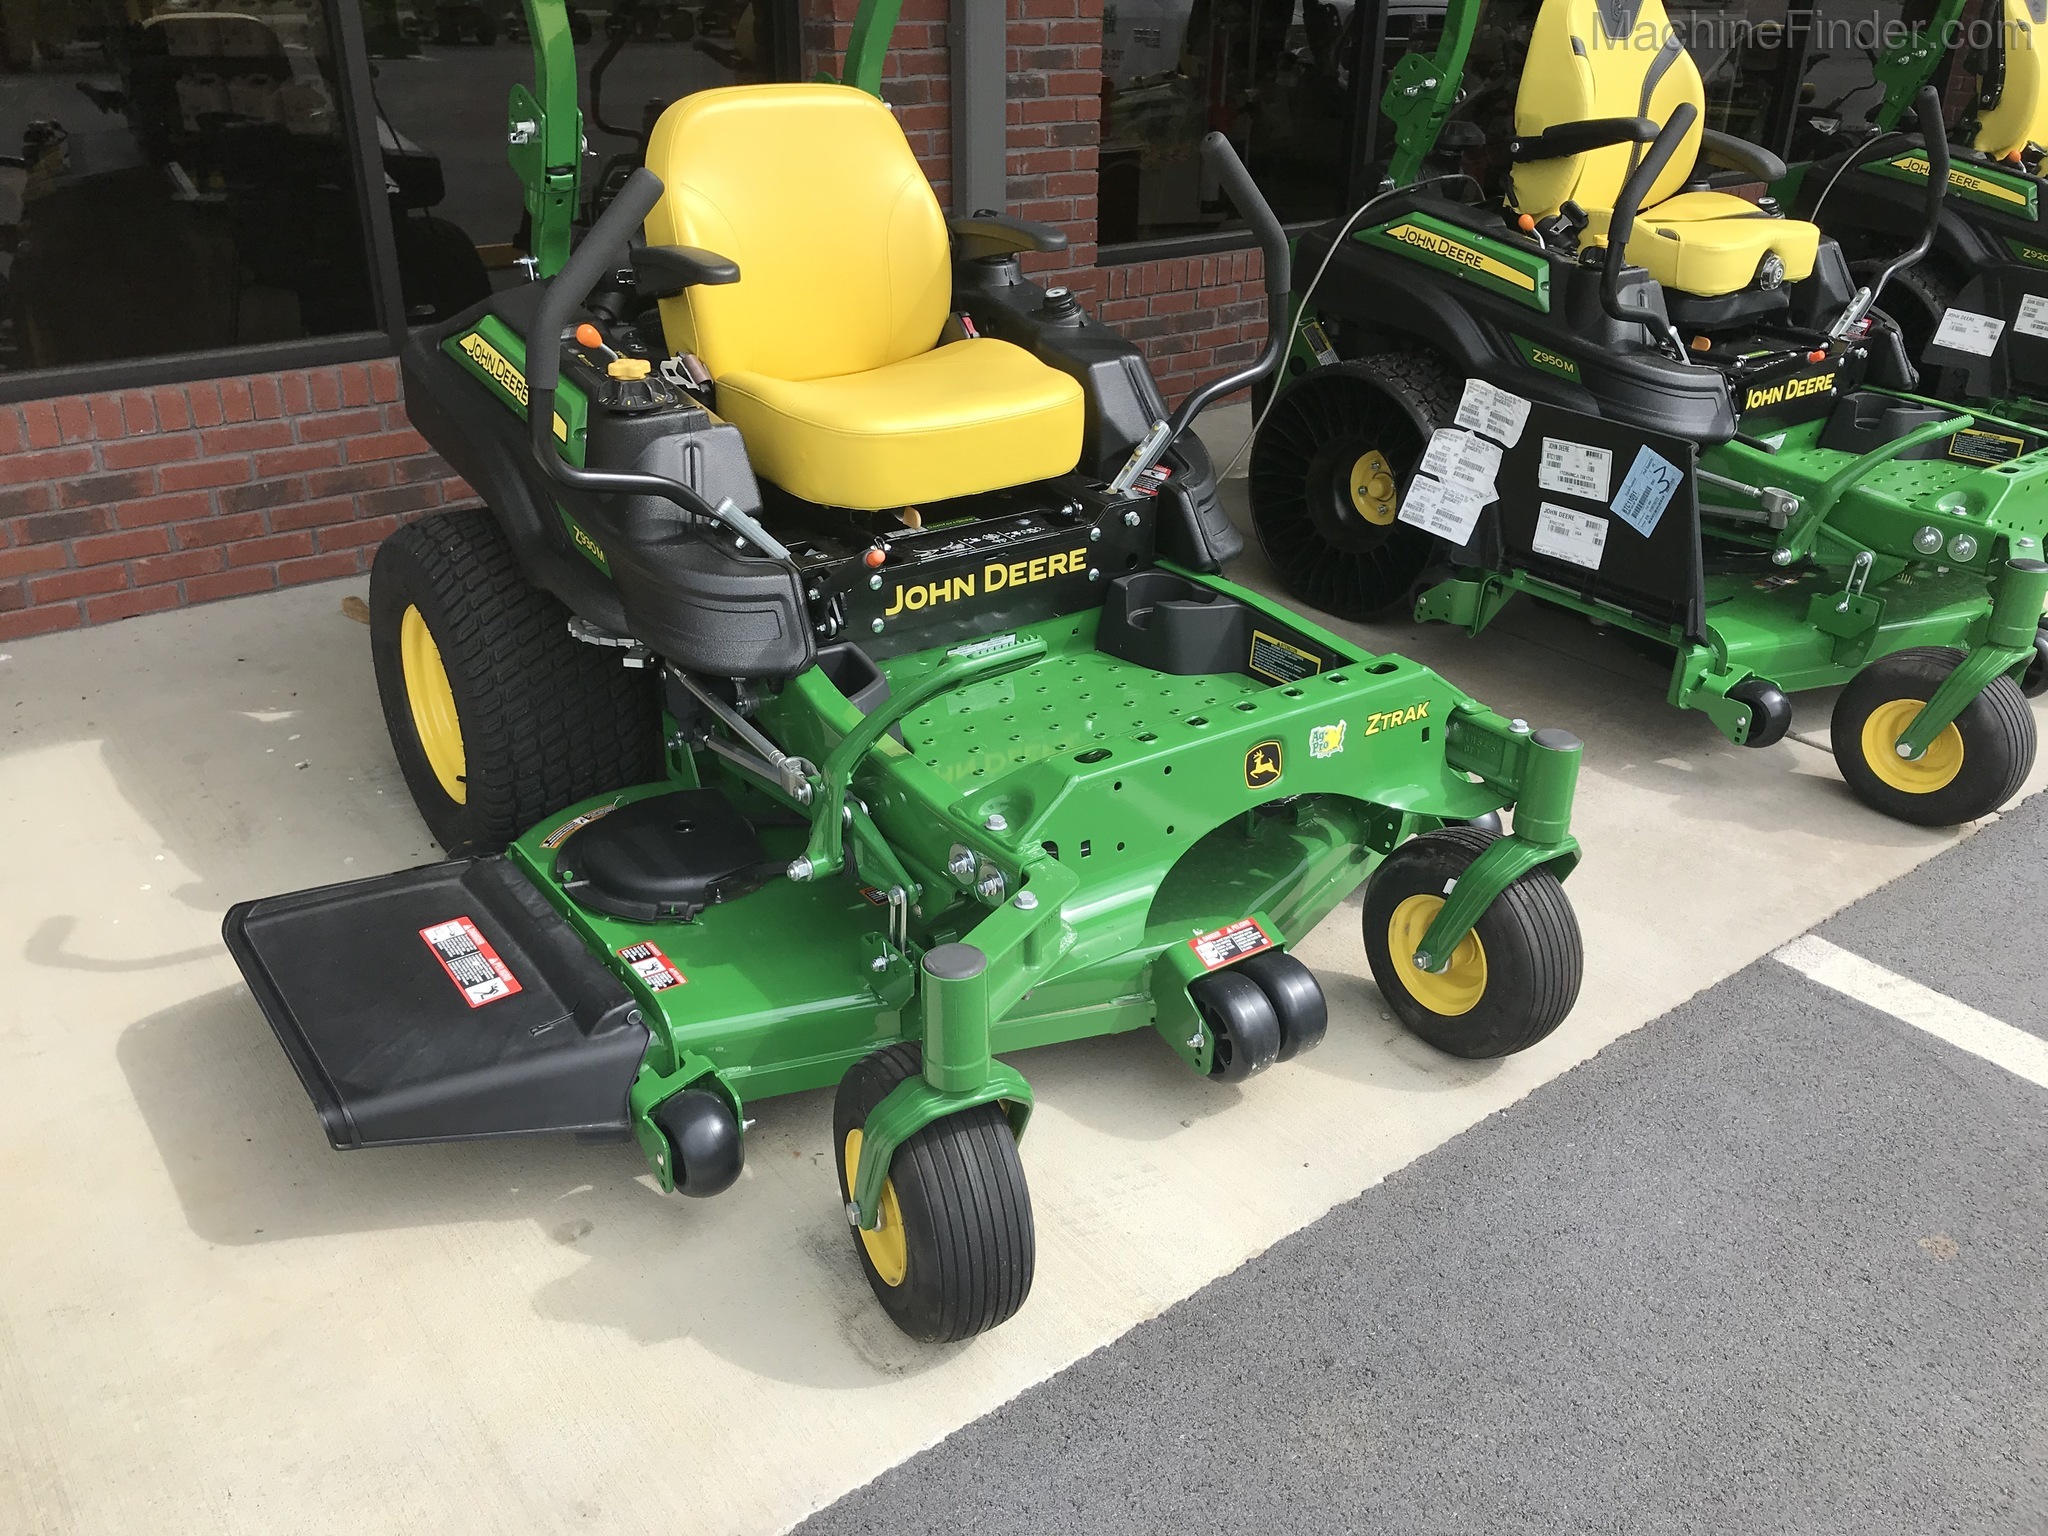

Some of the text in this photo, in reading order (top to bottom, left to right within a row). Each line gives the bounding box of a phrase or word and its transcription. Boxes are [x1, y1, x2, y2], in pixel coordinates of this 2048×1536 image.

[1904, 160, 1981, 189] JOH EERE
[1400, 227, 1484, 269] JOHN DEERE
[469, 337, 529, 403] JOHN DEERE
[1532, 349, 1575, 374] Z950M
[1745, 373, 1836, 410] JOHN DEERE
[1548, 442, 1570, 453] JOHN DEERE
[1653, 466, 1670, 495] 3
[1543, 507, 1575, 522] JOHN DEERE
[885, 547, 1088, 616] JOHN DEERE
[1364, 701, 1430, 737] ZTRAK
